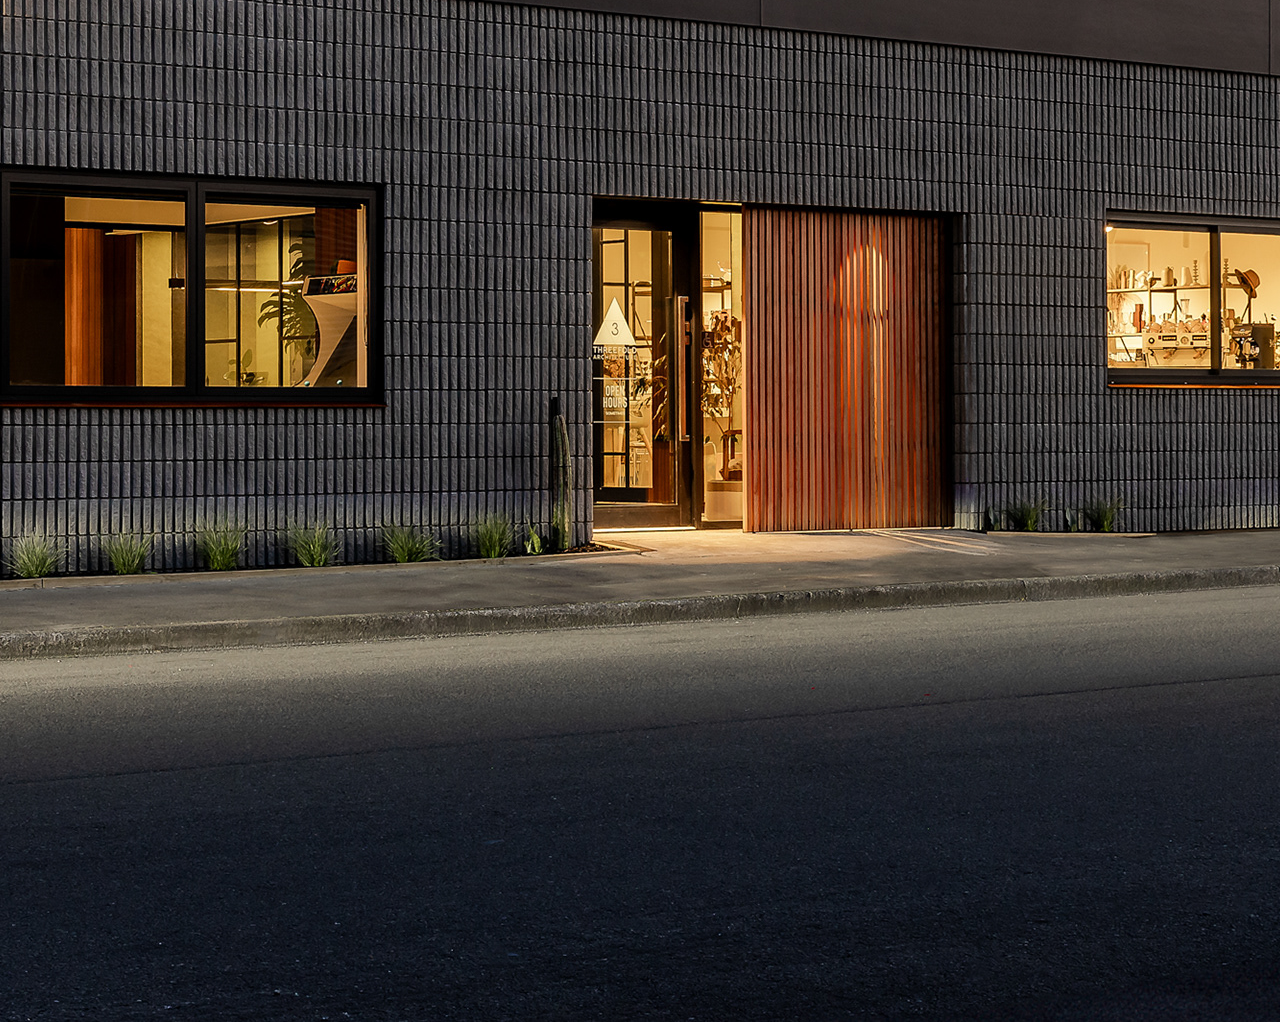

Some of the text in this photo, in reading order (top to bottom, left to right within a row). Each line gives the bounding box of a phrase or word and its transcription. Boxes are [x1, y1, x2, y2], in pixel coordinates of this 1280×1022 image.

[611, 322, 619, 336] 3
[592, 346, 637, 354] THREEFOLD
[605, 385, 625, 396] OPEN
[602, 396, 628, 408] HOURS
